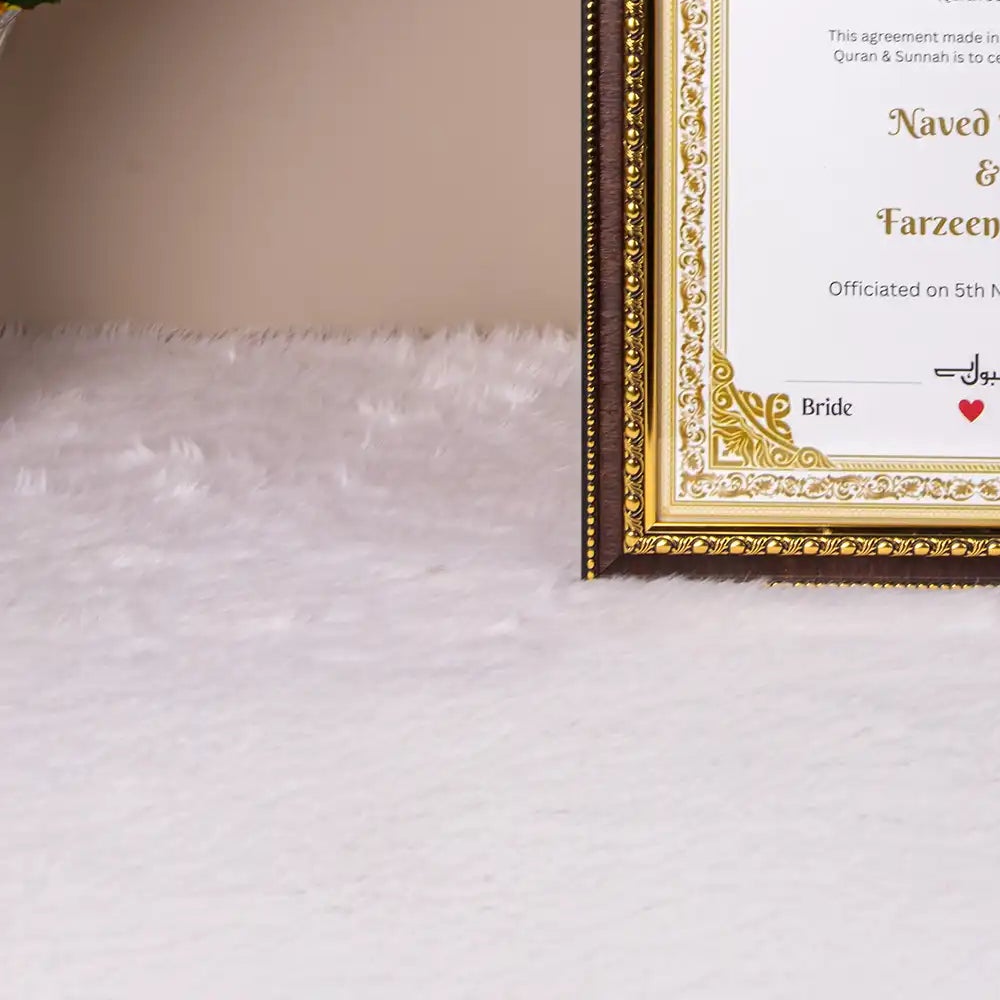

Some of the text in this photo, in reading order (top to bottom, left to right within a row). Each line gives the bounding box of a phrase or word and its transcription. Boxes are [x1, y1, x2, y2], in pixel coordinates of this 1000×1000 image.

[827, 28, 858, 43] This
[860, 31, 940, 46] agreement
[942, 30, 985, 45] made
[986, 31, 1000, 44] in
[833, 48, 878, 65] Quran
[881, 49, 892, 63] &
[894, 50, 950, 64] Sunnah
[952, 50, 965, 64] is
[967, 52, 984, 64] to
[887, 106, 991, 140] Naved
[974, 158, 1000, 188] &
[828, 280, 921, 298] Officiated
[925, 285, 949, 298] on
[954, 279, 985, 299] 5th
[801, 396, 854, 417] Bride
